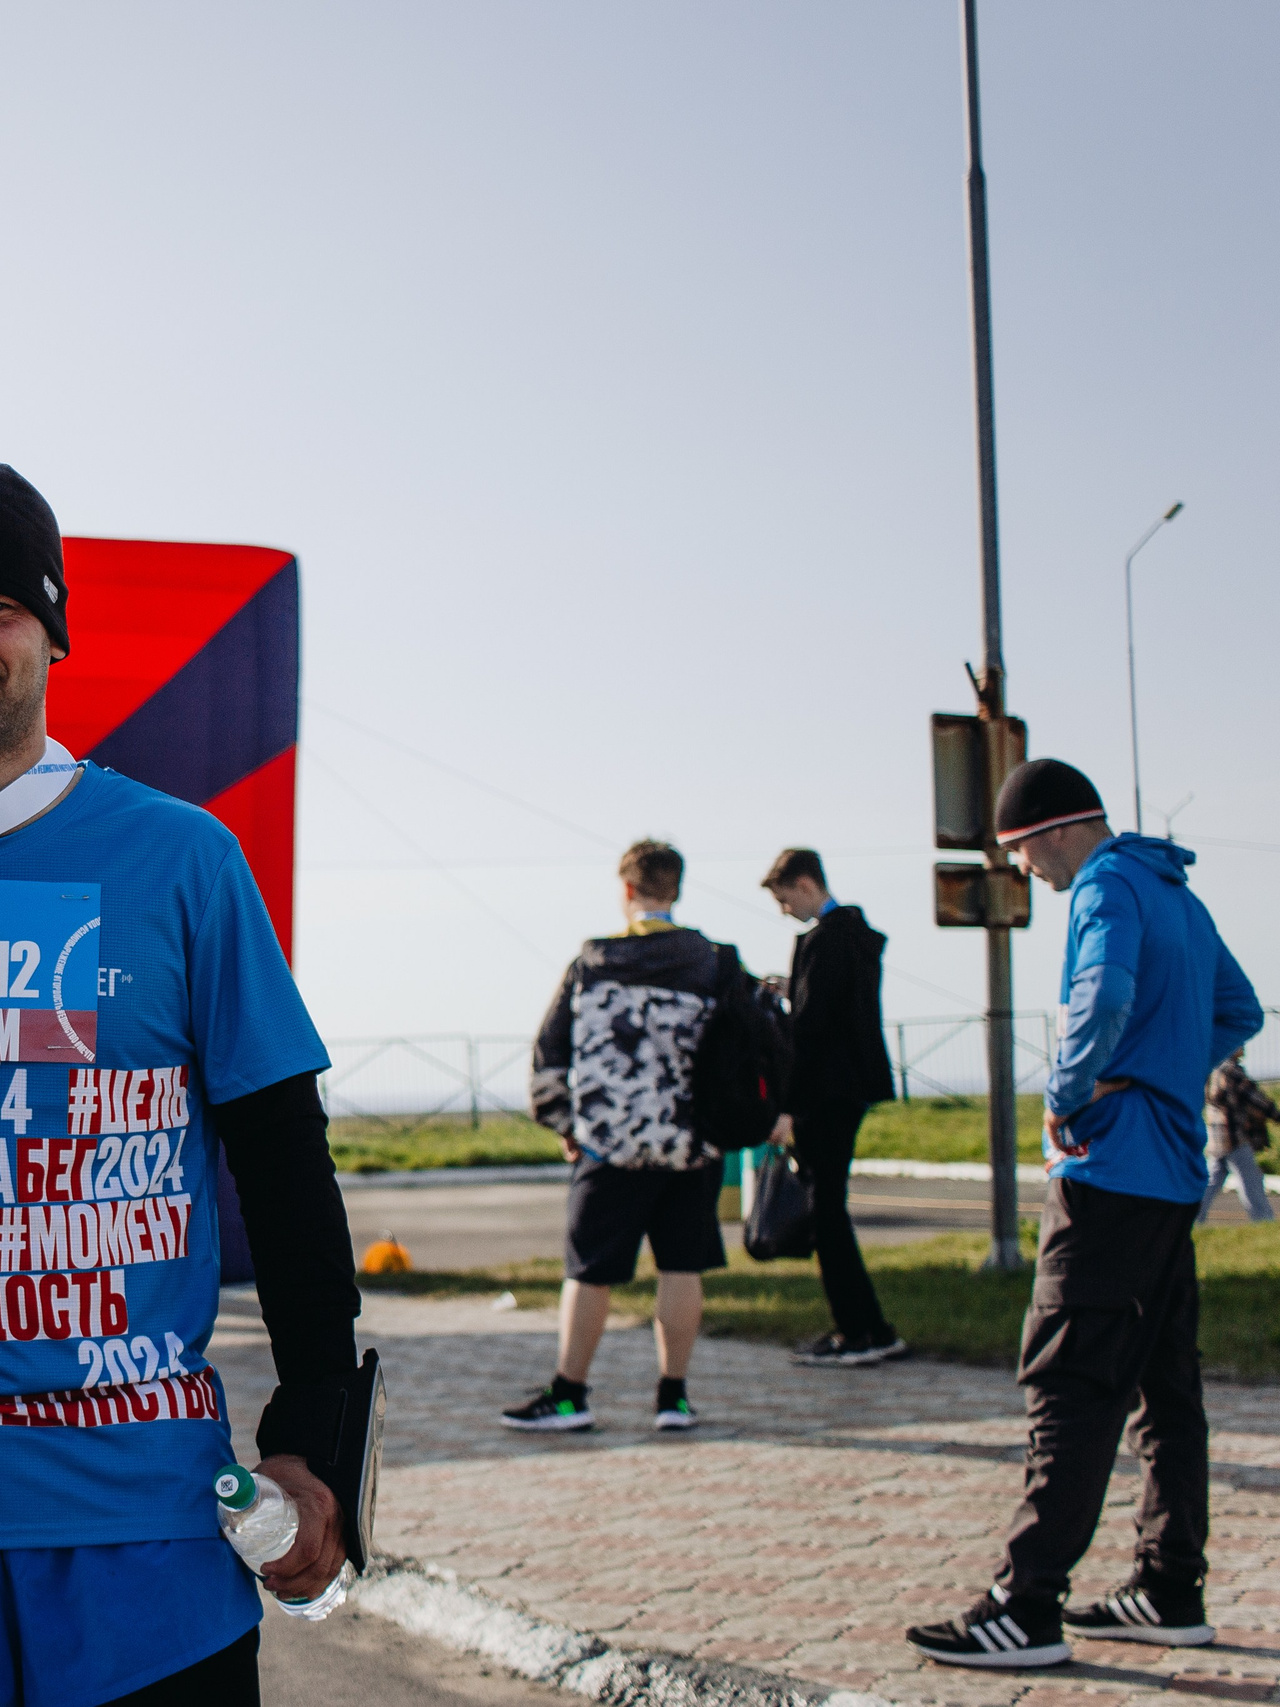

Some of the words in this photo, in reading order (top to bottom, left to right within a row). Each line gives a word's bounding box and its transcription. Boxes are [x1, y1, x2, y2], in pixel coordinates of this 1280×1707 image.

[74, 1040, 96, 1062] #МЕЧТА
[68, 1066, 190, 1135] #ЦЕЛЬ
[78, 1331, 190, 1390] 2024
